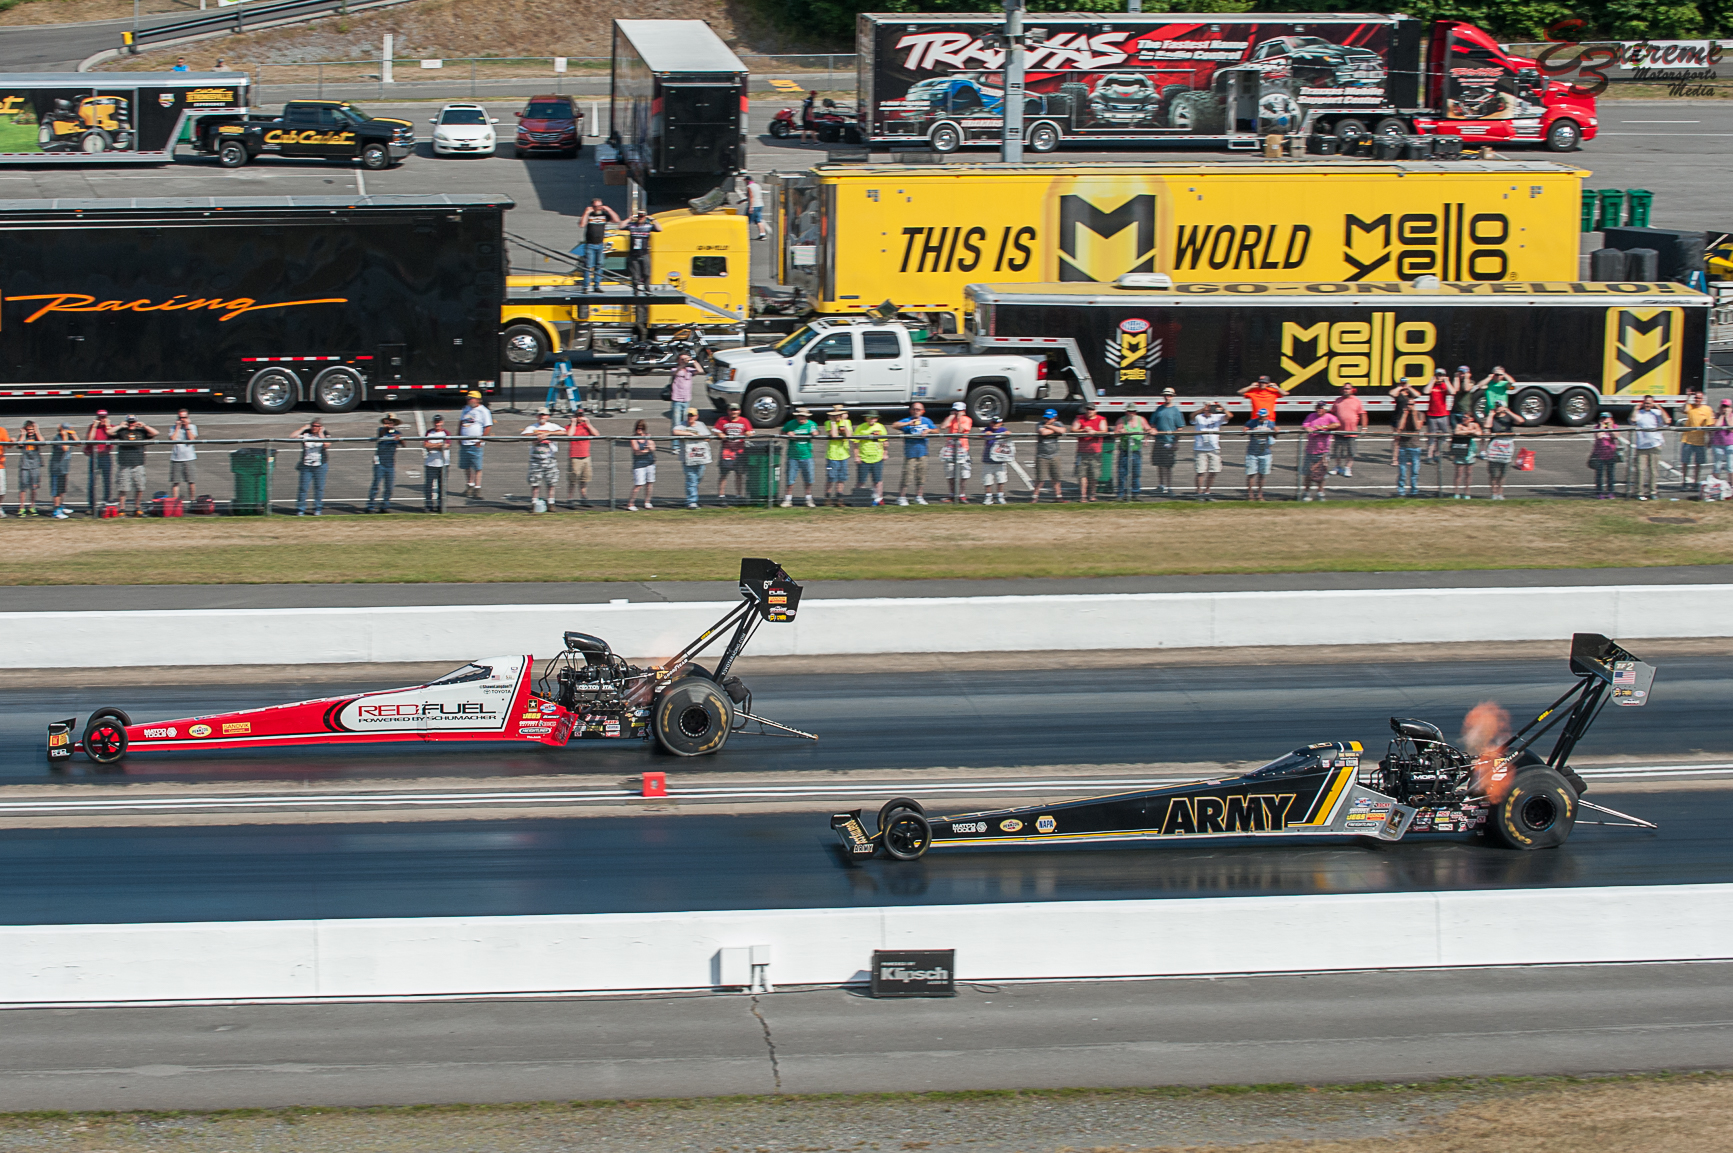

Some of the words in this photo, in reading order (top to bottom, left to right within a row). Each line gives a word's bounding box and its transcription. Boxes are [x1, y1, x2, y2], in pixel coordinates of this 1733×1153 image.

[899, 226, 987, 272] THIS
[993, 226, 1037, 272] IS
[1174, 224, 1312, 270] WORLD
[1175, 283, 1402, 294] GO-ON
[1444, 282, 1677, 294] YELLO!
[5, 293, 348, 323] Racing
[358, 704, 419, 717] RED
[421, 702, 497, 715] FUEL
[1160, 794, 1297, 836] ARMY
[1038, 819, 1054, 829] NAPA
[853, 844, 874, 853] ARMY
[881, 966, 949, 983] Klipsch
